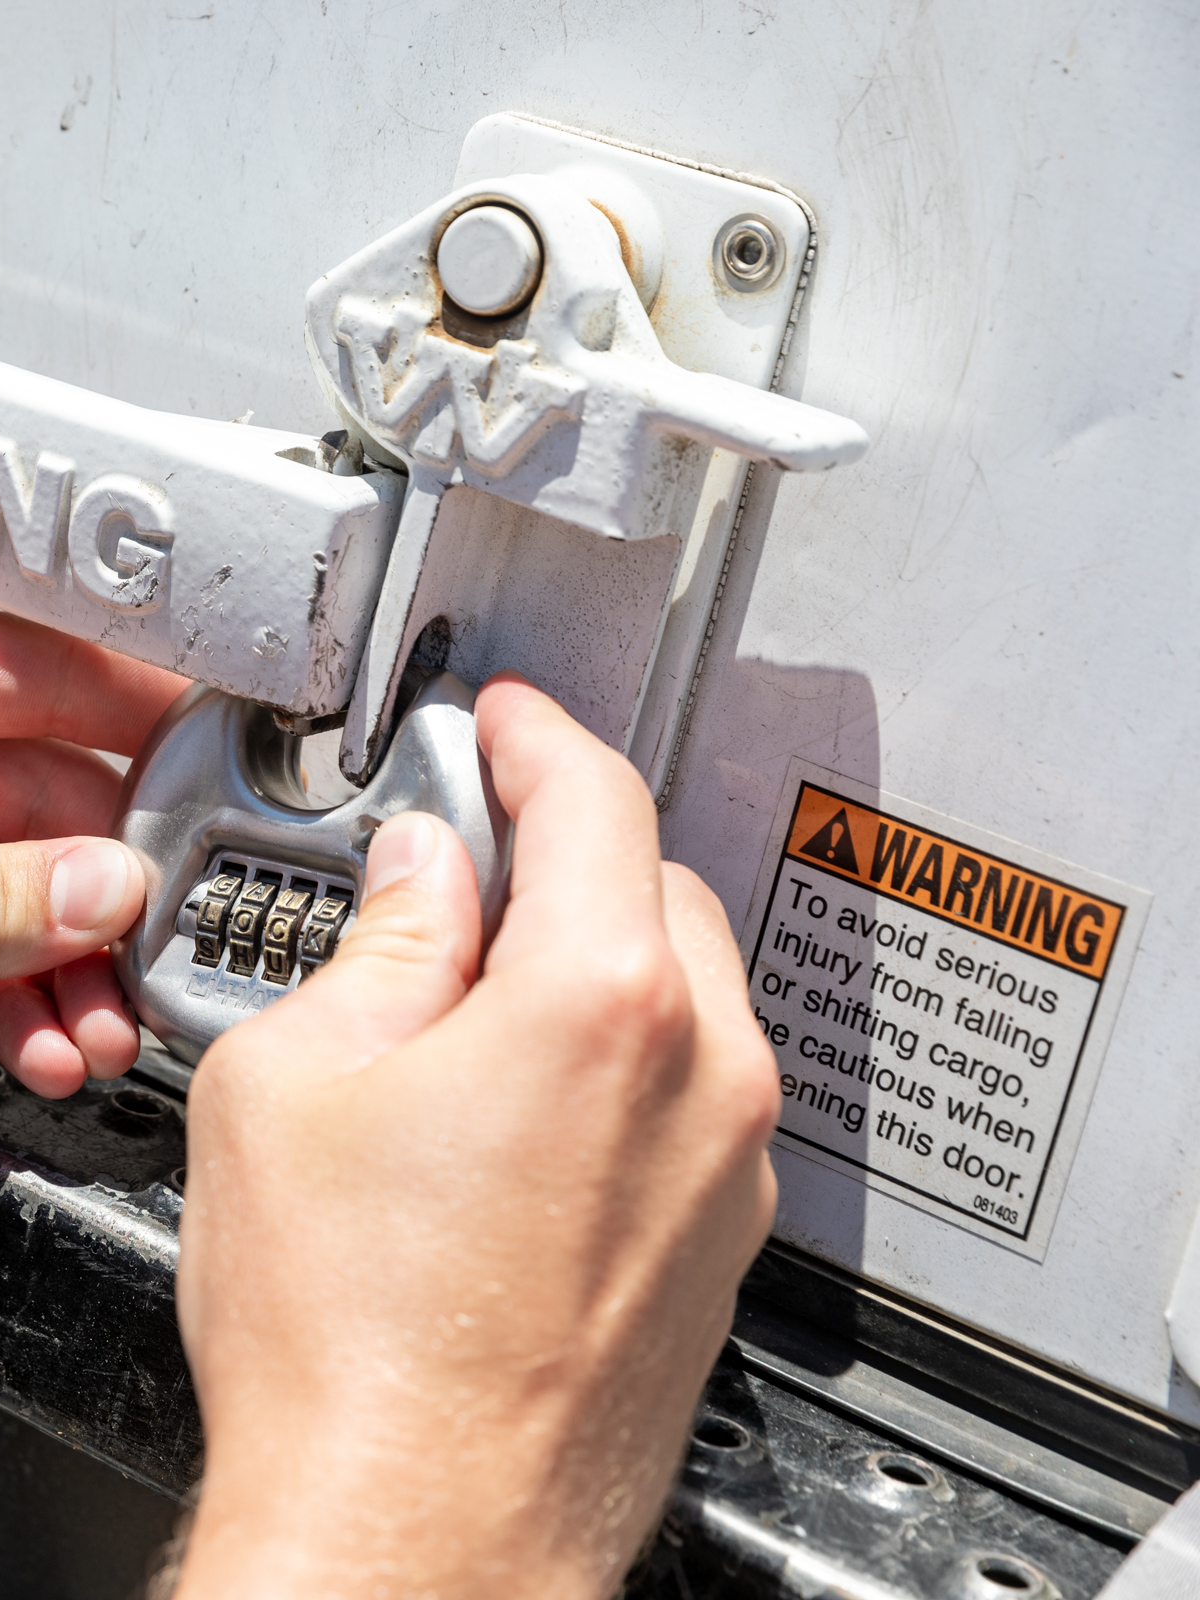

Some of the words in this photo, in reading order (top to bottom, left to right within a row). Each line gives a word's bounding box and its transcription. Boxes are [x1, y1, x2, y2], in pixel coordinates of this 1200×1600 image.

[199, 902, 326, 952] LOCK
[789, 877, 828, 919] To
[836, 907, 928, 961] avoid
[935, 947, 1059, 1014] serious
[869, 821, 1106, 967] WARNING
[185, 973, 281, 1012] U-HA
[761, 972, 797, 1001] or
[802, 988, 920, 1061] shifting
[928, 1042, 1030, 1108] cargo,
[773, 921, 863, 986] injury
[869, 961, 944, 1017] from
[954, 997, 1054, 1068] falling
[779, 1073, 867, 1134] ening
[875, 1109, 934, 1157] this
[942, 1142, 1025, 1199] door.
[799, 1035, 936, 1110] cautious
[947, 1096, 1036, 1154] when
[972, 1193, 1019, 1225] 081403
